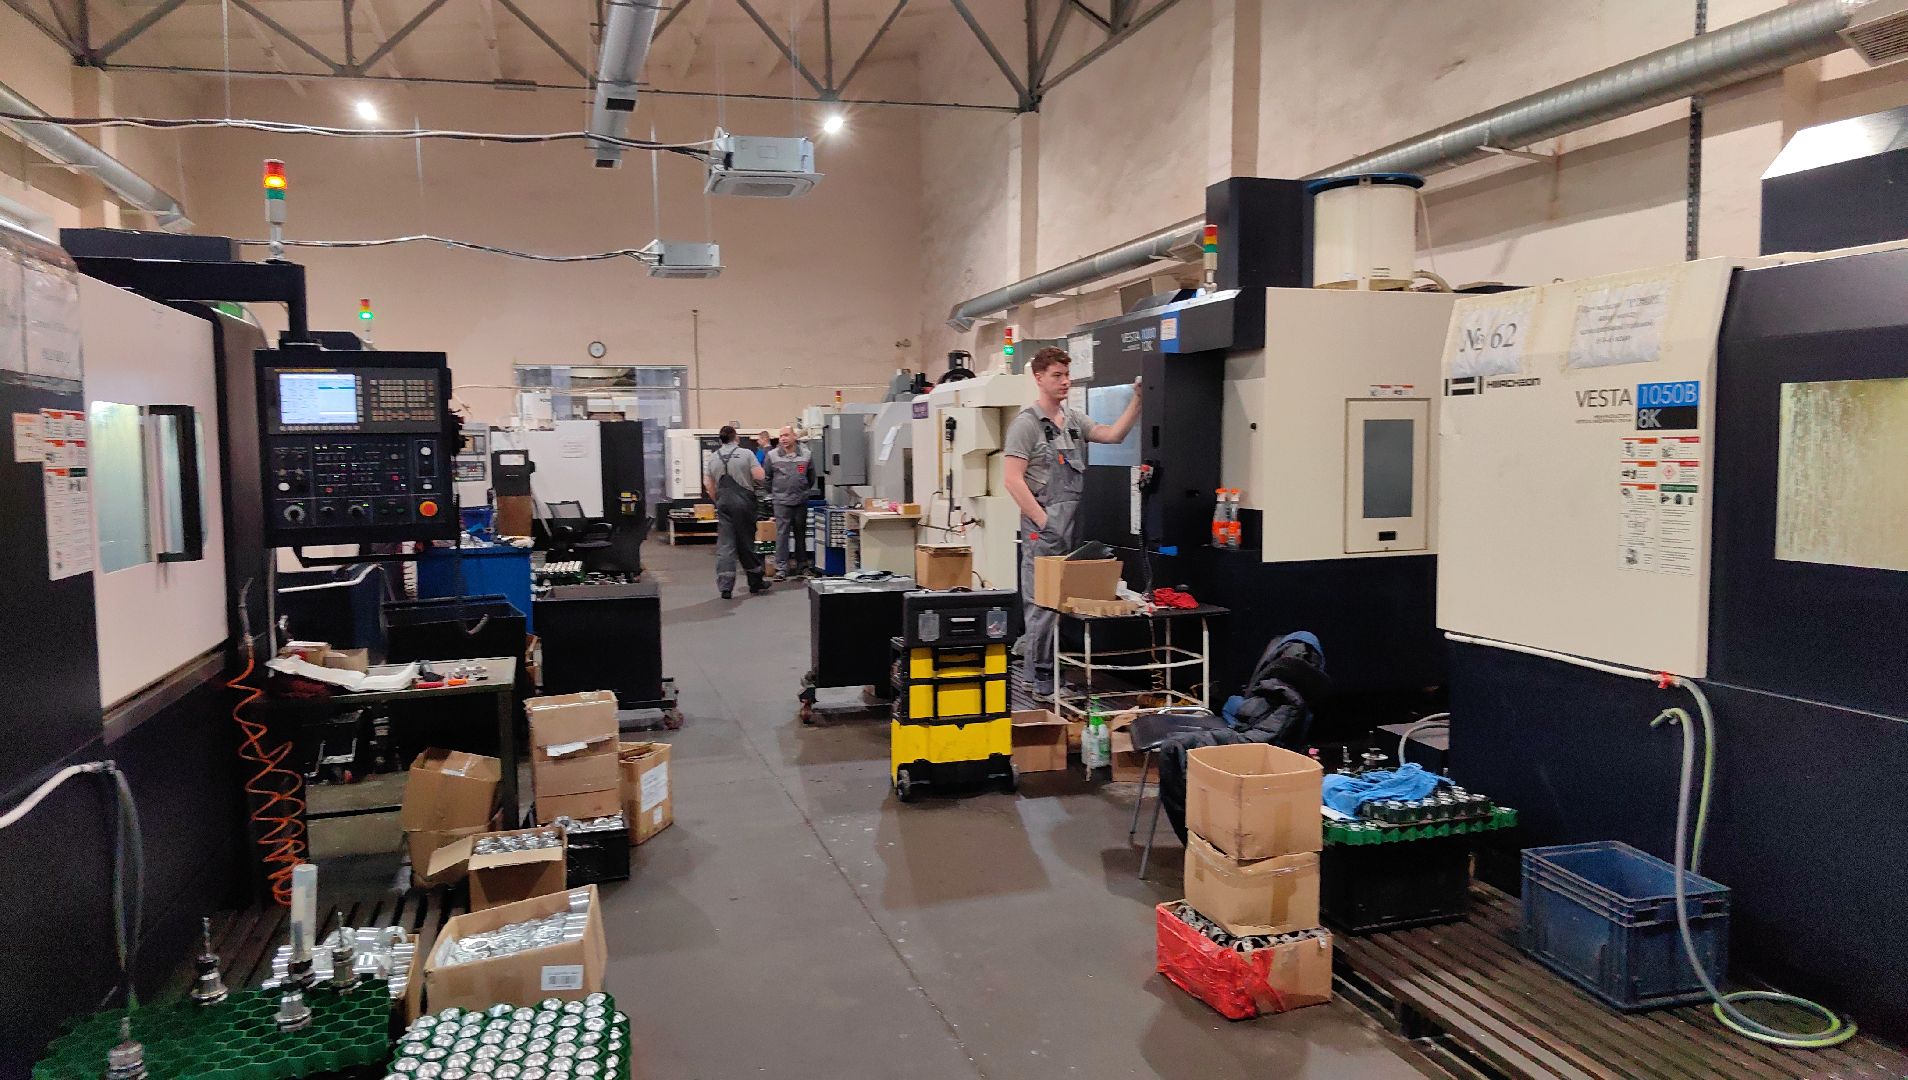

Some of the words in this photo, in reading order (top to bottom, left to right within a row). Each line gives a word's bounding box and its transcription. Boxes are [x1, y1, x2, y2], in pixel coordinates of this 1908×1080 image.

[1490, 323, 1517, 348] 62
[1575, 388, 1633, 408] VESTA
[1641, 383, 1698, 405] 1050B
[1638, 408, 1662, 429] 8K
